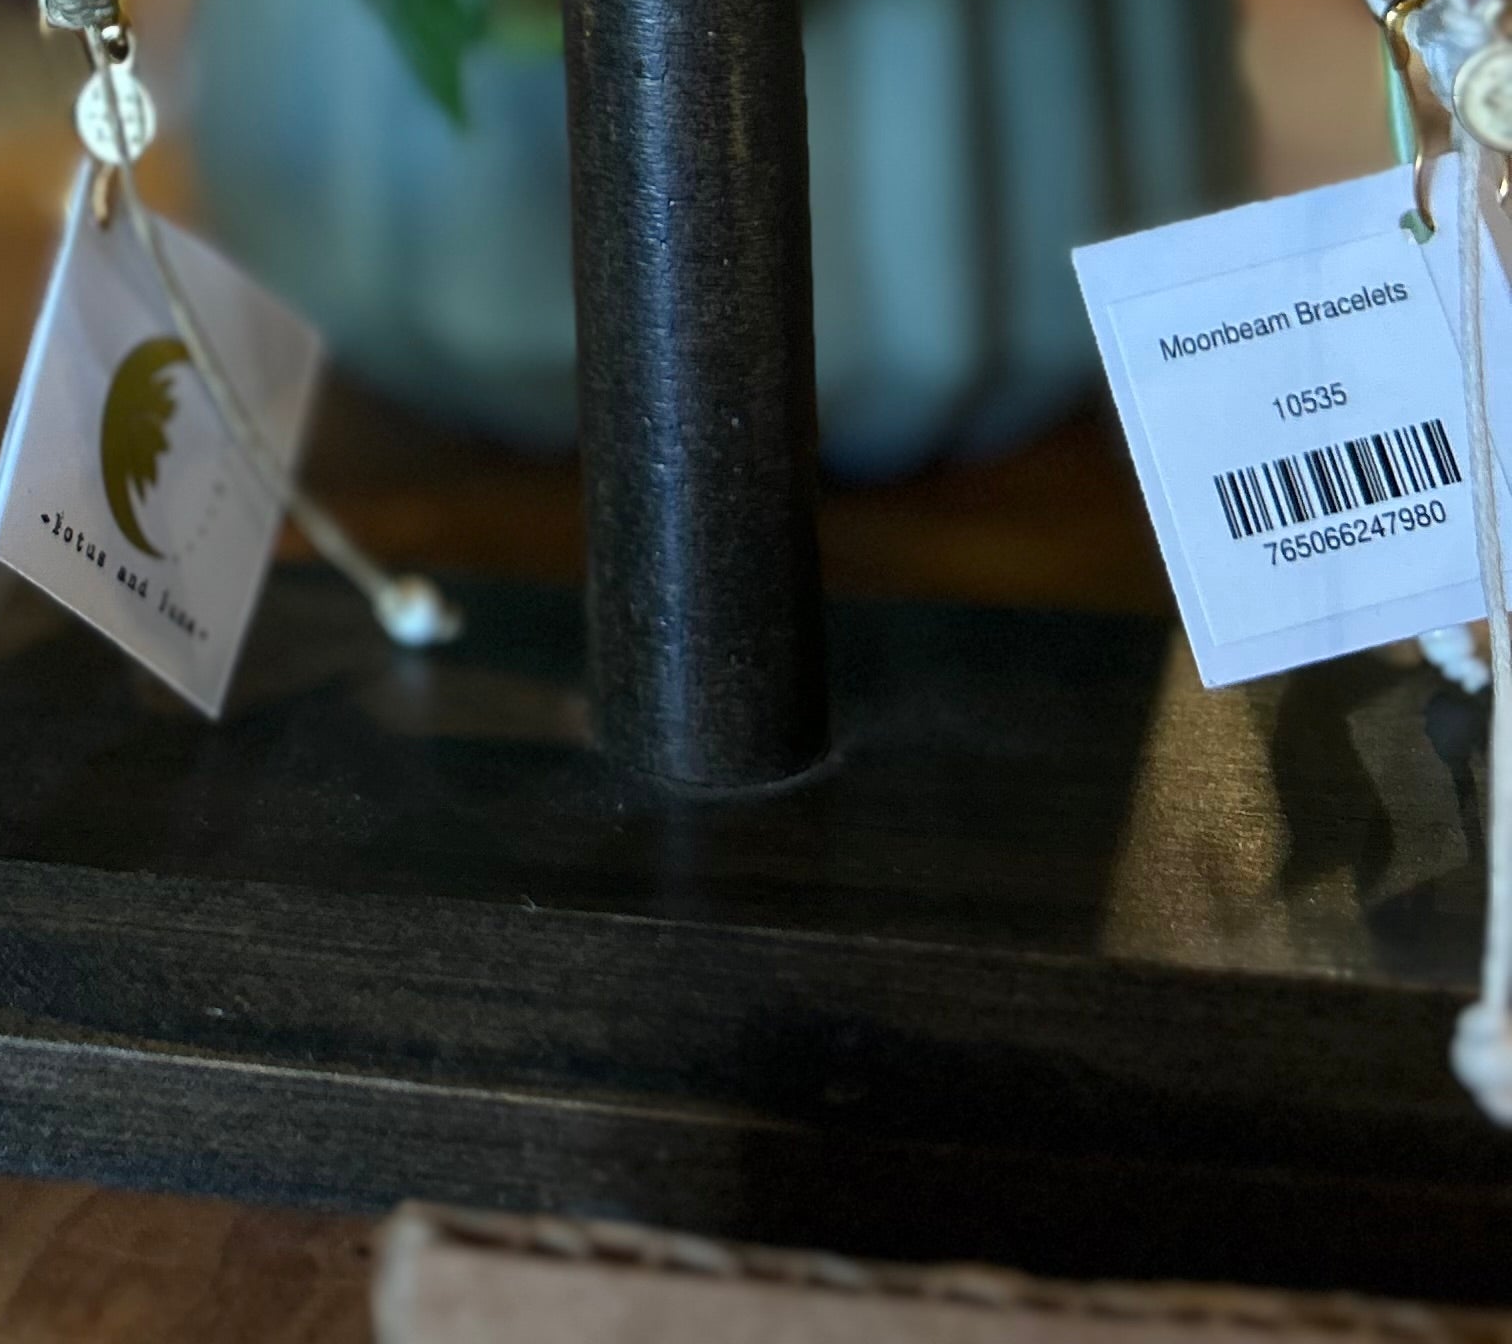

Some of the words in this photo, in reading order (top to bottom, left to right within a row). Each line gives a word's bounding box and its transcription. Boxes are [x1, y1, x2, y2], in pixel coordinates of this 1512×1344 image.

[1159, 312, 1292, 362] Moonbeam
[1294, 282, 1409, 326] Bracelets
[1273, 382, 1348, 421] 10535
[1263, 499, 1448, 566] 765066247980
[117, 565, 149, 599] and
